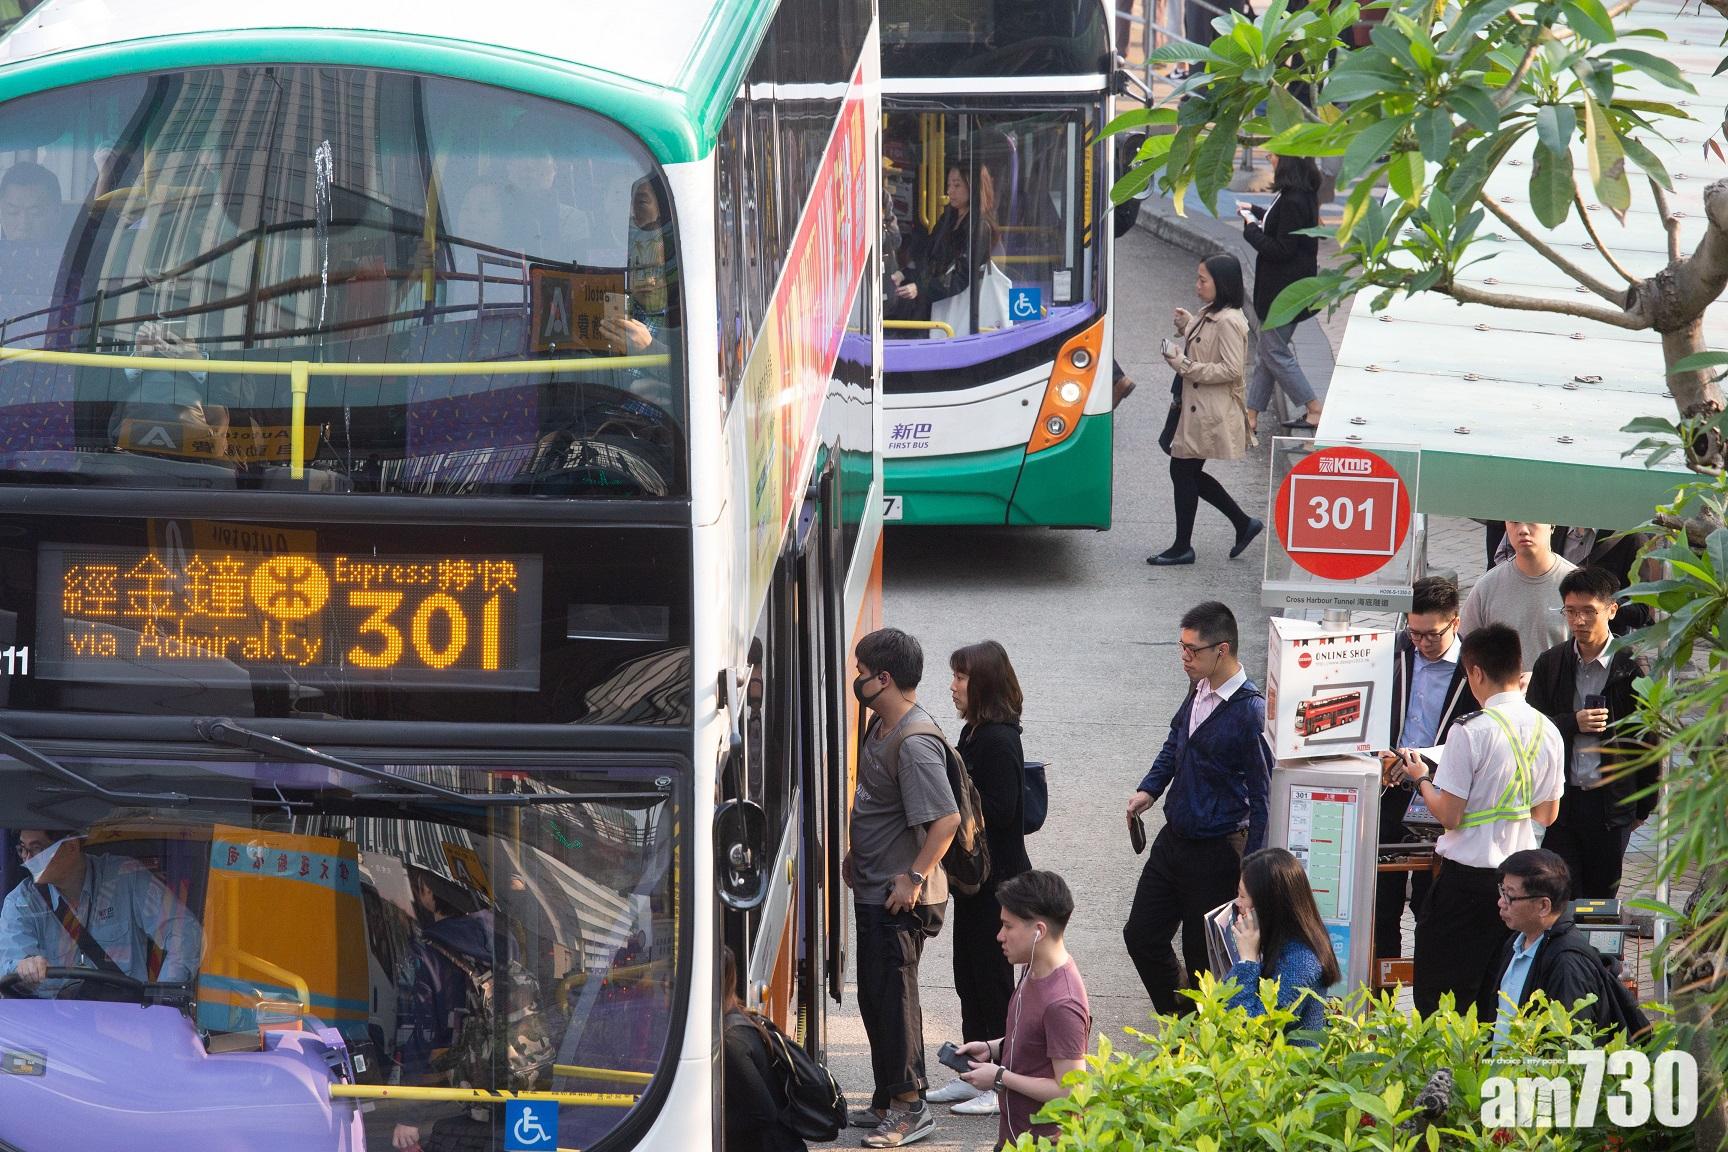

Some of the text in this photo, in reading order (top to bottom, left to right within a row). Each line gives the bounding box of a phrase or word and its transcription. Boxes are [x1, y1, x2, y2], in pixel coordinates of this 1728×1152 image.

[891, 423, 932, 440] 新巴
[912, 441, 929, 449] BUS
[1334, 457, 1372, 474] KMB
[1307, 495, 1374, 531] 301
[63, 553, 248, 617] 經金鐘
[336, 557, 517, 592] Express 特快
[1285, 595, 1305, 604] Cross
[1306, 596, 1333, 605] Harbour
[1334, 597, 1356, 606] Tunnel
[348, 591, 499, 669] 301
[70, 618, 321, 666] via Admiralty
[0, 645, 28, 675] 11
[1315, 650, 1347, 661] ONLINE
[1349, 648, 1371, 659] SHOP
[1295, 791, 1308, 799] 301
